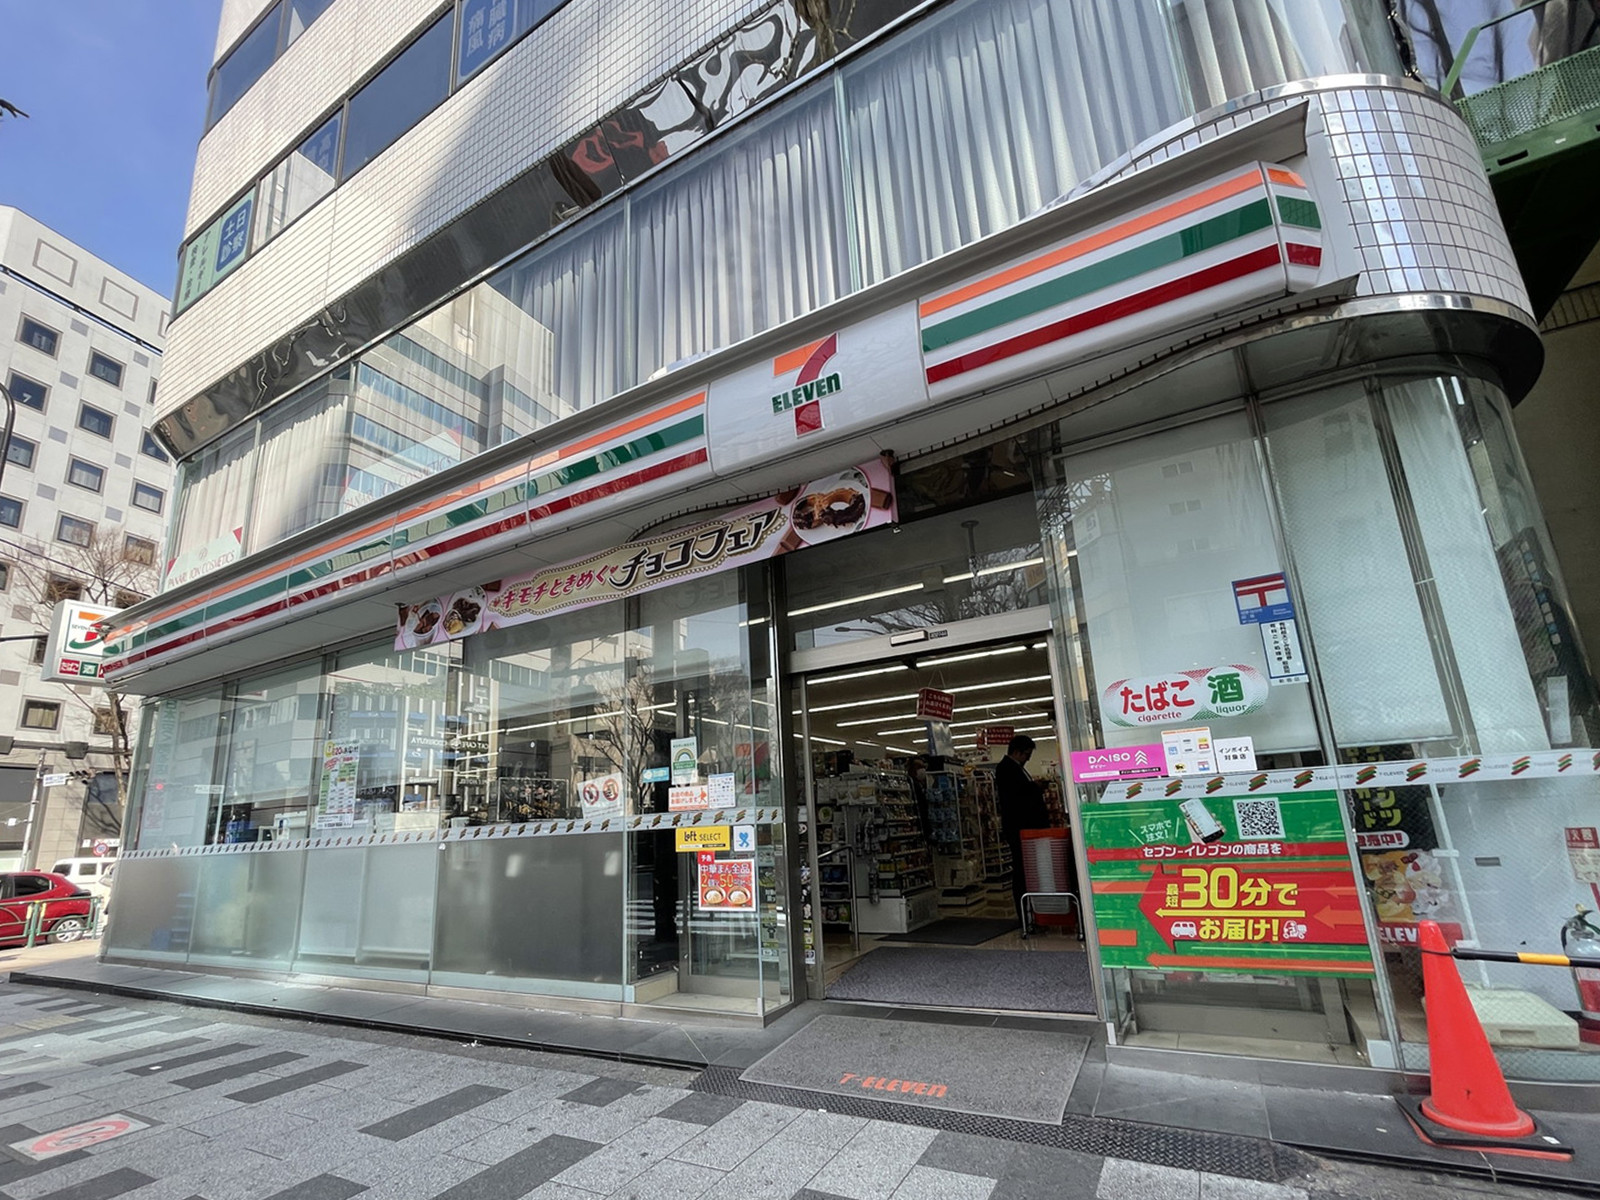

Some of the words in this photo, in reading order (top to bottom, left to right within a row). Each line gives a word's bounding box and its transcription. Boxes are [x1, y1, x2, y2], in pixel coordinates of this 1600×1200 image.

[503, 564, 610, 610] キモチときめく
[608, 506, 780, 590] チョコフェア
[1207, 672, 1244, 704] 酒
[1119, 680, 1195, 714] たばこ
[1215, 704, 1247, 715] liquor
[1137, 711, 1182, 722] cigarette
[1219, 746, 1250, 754] インボイス
[1088, 752, 1131, 764] DAISO
[1141, 820, 1172, 834] スマホで
[699, 833, 721, 842] SELECT
[701, 854, 712, 862] 予告
[700, 863, 751, 875] 中華まん全品
[1165, 883, 1178, 908] 最短
[1181, 867, 1298, 908] 30分で
[1198, 918, 1280, 941] お届け!
